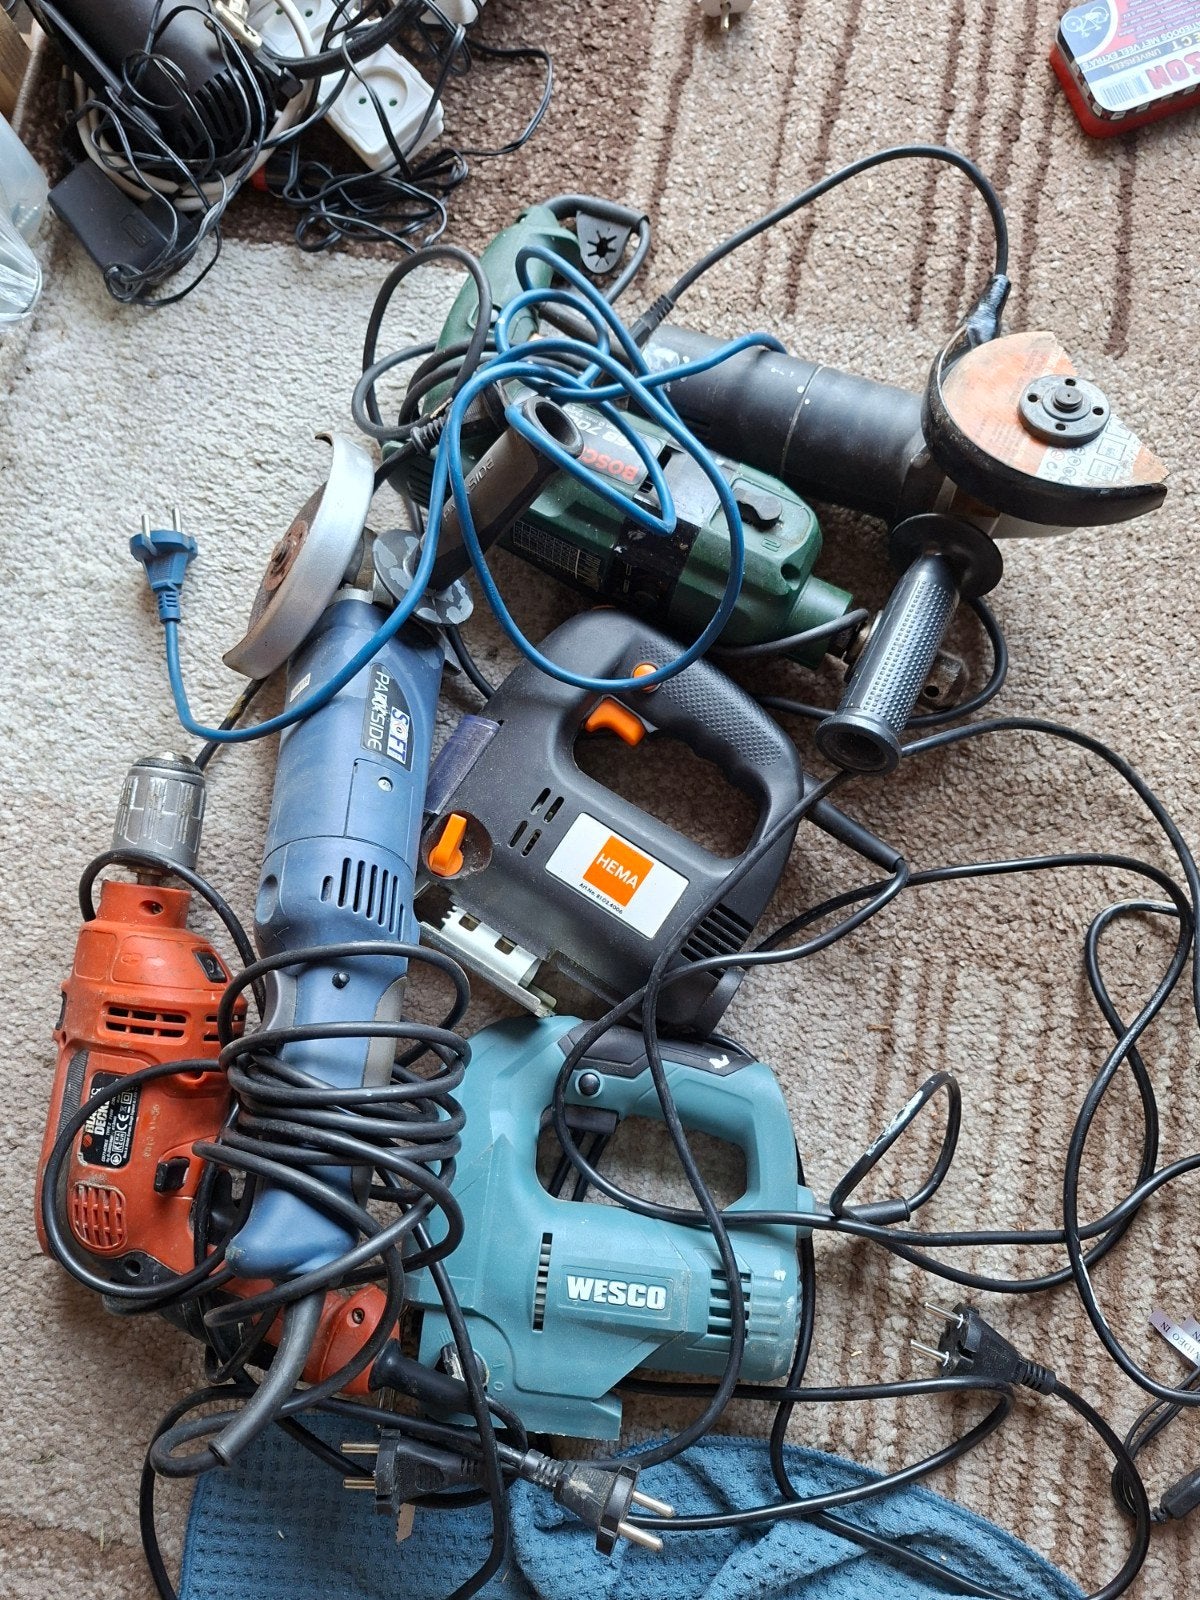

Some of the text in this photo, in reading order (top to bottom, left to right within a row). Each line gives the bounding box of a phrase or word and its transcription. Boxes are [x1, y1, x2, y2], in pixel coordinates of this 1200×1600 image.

[1110, 48, 1161, 71] UNIVERSEEL
[580, 448, 639, 481] BOSC
[444, 457, 495, 519] PASIDE
[596, 853, 640, 890] HEMA
[94, 1100, 110, 1135] DECK
[567, 1275, 667, 1310] WESCO
[1161, 1322, 1200, 1359] VIDEO IN
